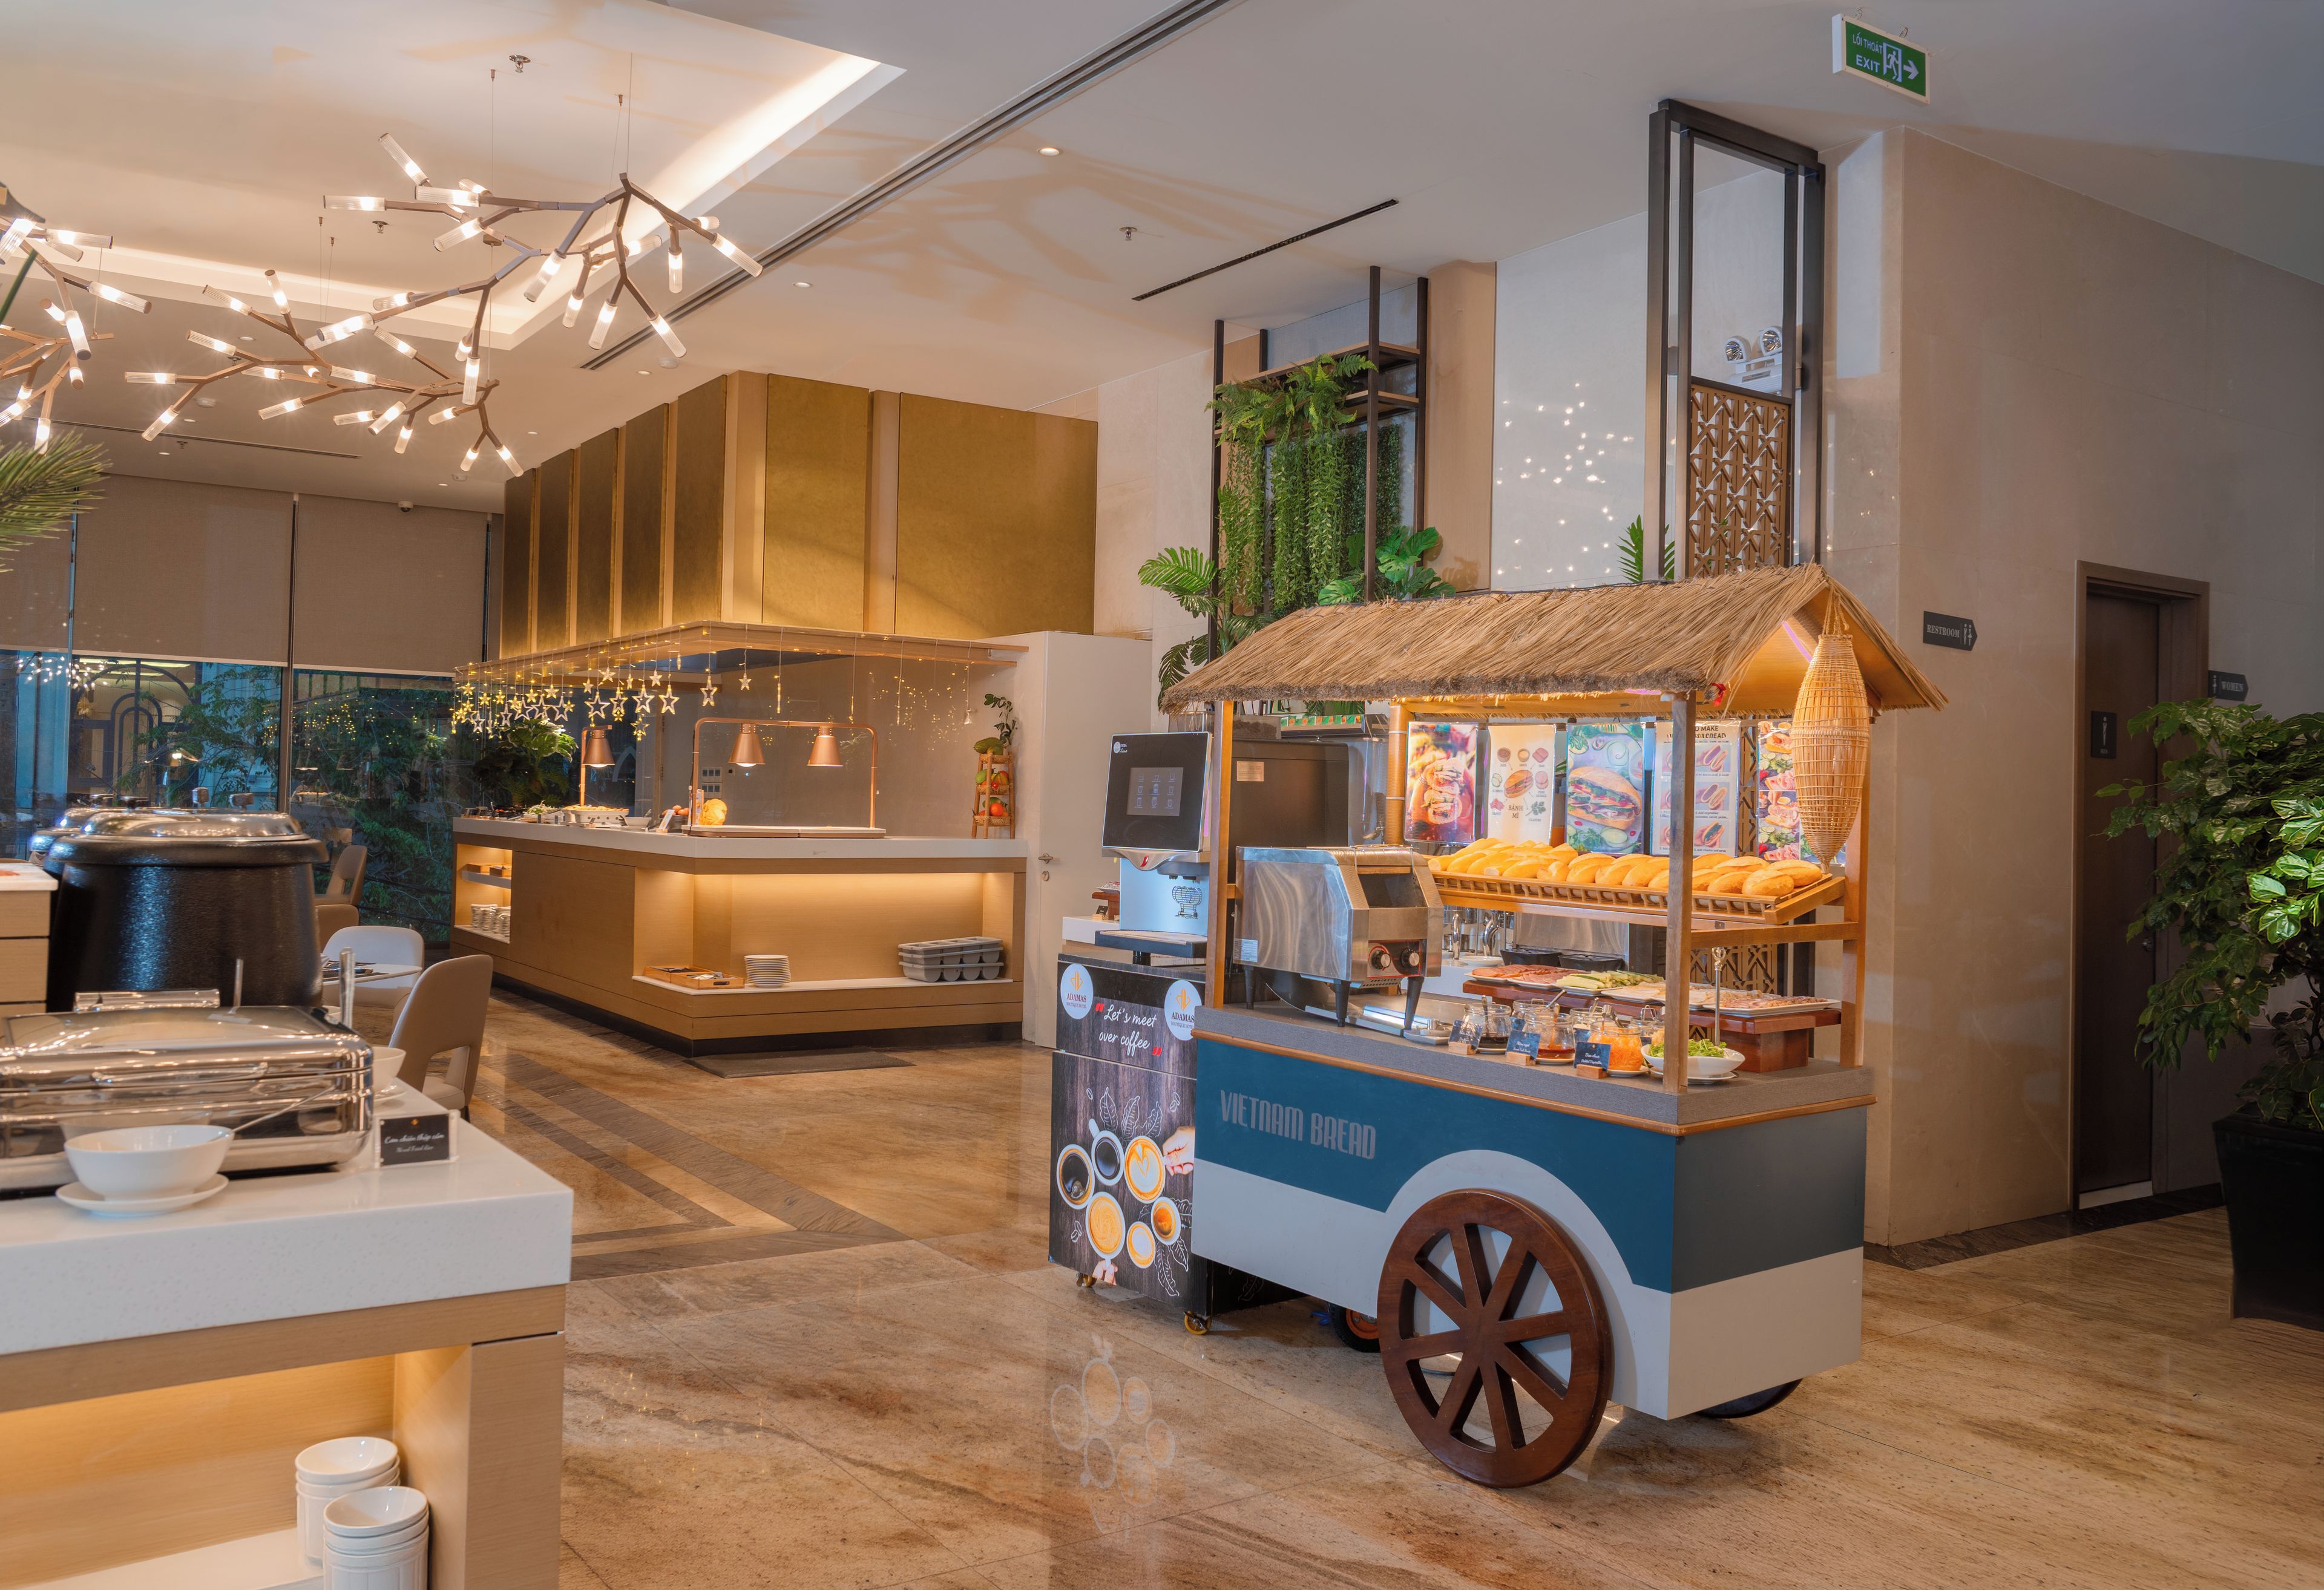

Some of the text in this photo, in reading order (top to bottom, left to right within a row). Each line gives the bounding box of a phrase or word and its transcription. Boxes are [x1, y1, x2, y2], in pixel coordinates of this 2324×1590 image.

[1863, 39, 1883, 54] THOÁT
[1856, 54, 1880, 73] EXIT
[1926, 624, 1960, 638] RESTROOM
[2221, 681, 2244, 692] WOMEN
[1066, 993, 1087, 1003] ADAMAS
[1132, 1014, 1157, 1027] meet
[1171, 1012, 1195, 1022] ADAMAS
[1099, 1030, 1151, 1056] over coffee
[1220, 1090, 1376, 1159] VIETNAM BREAD
